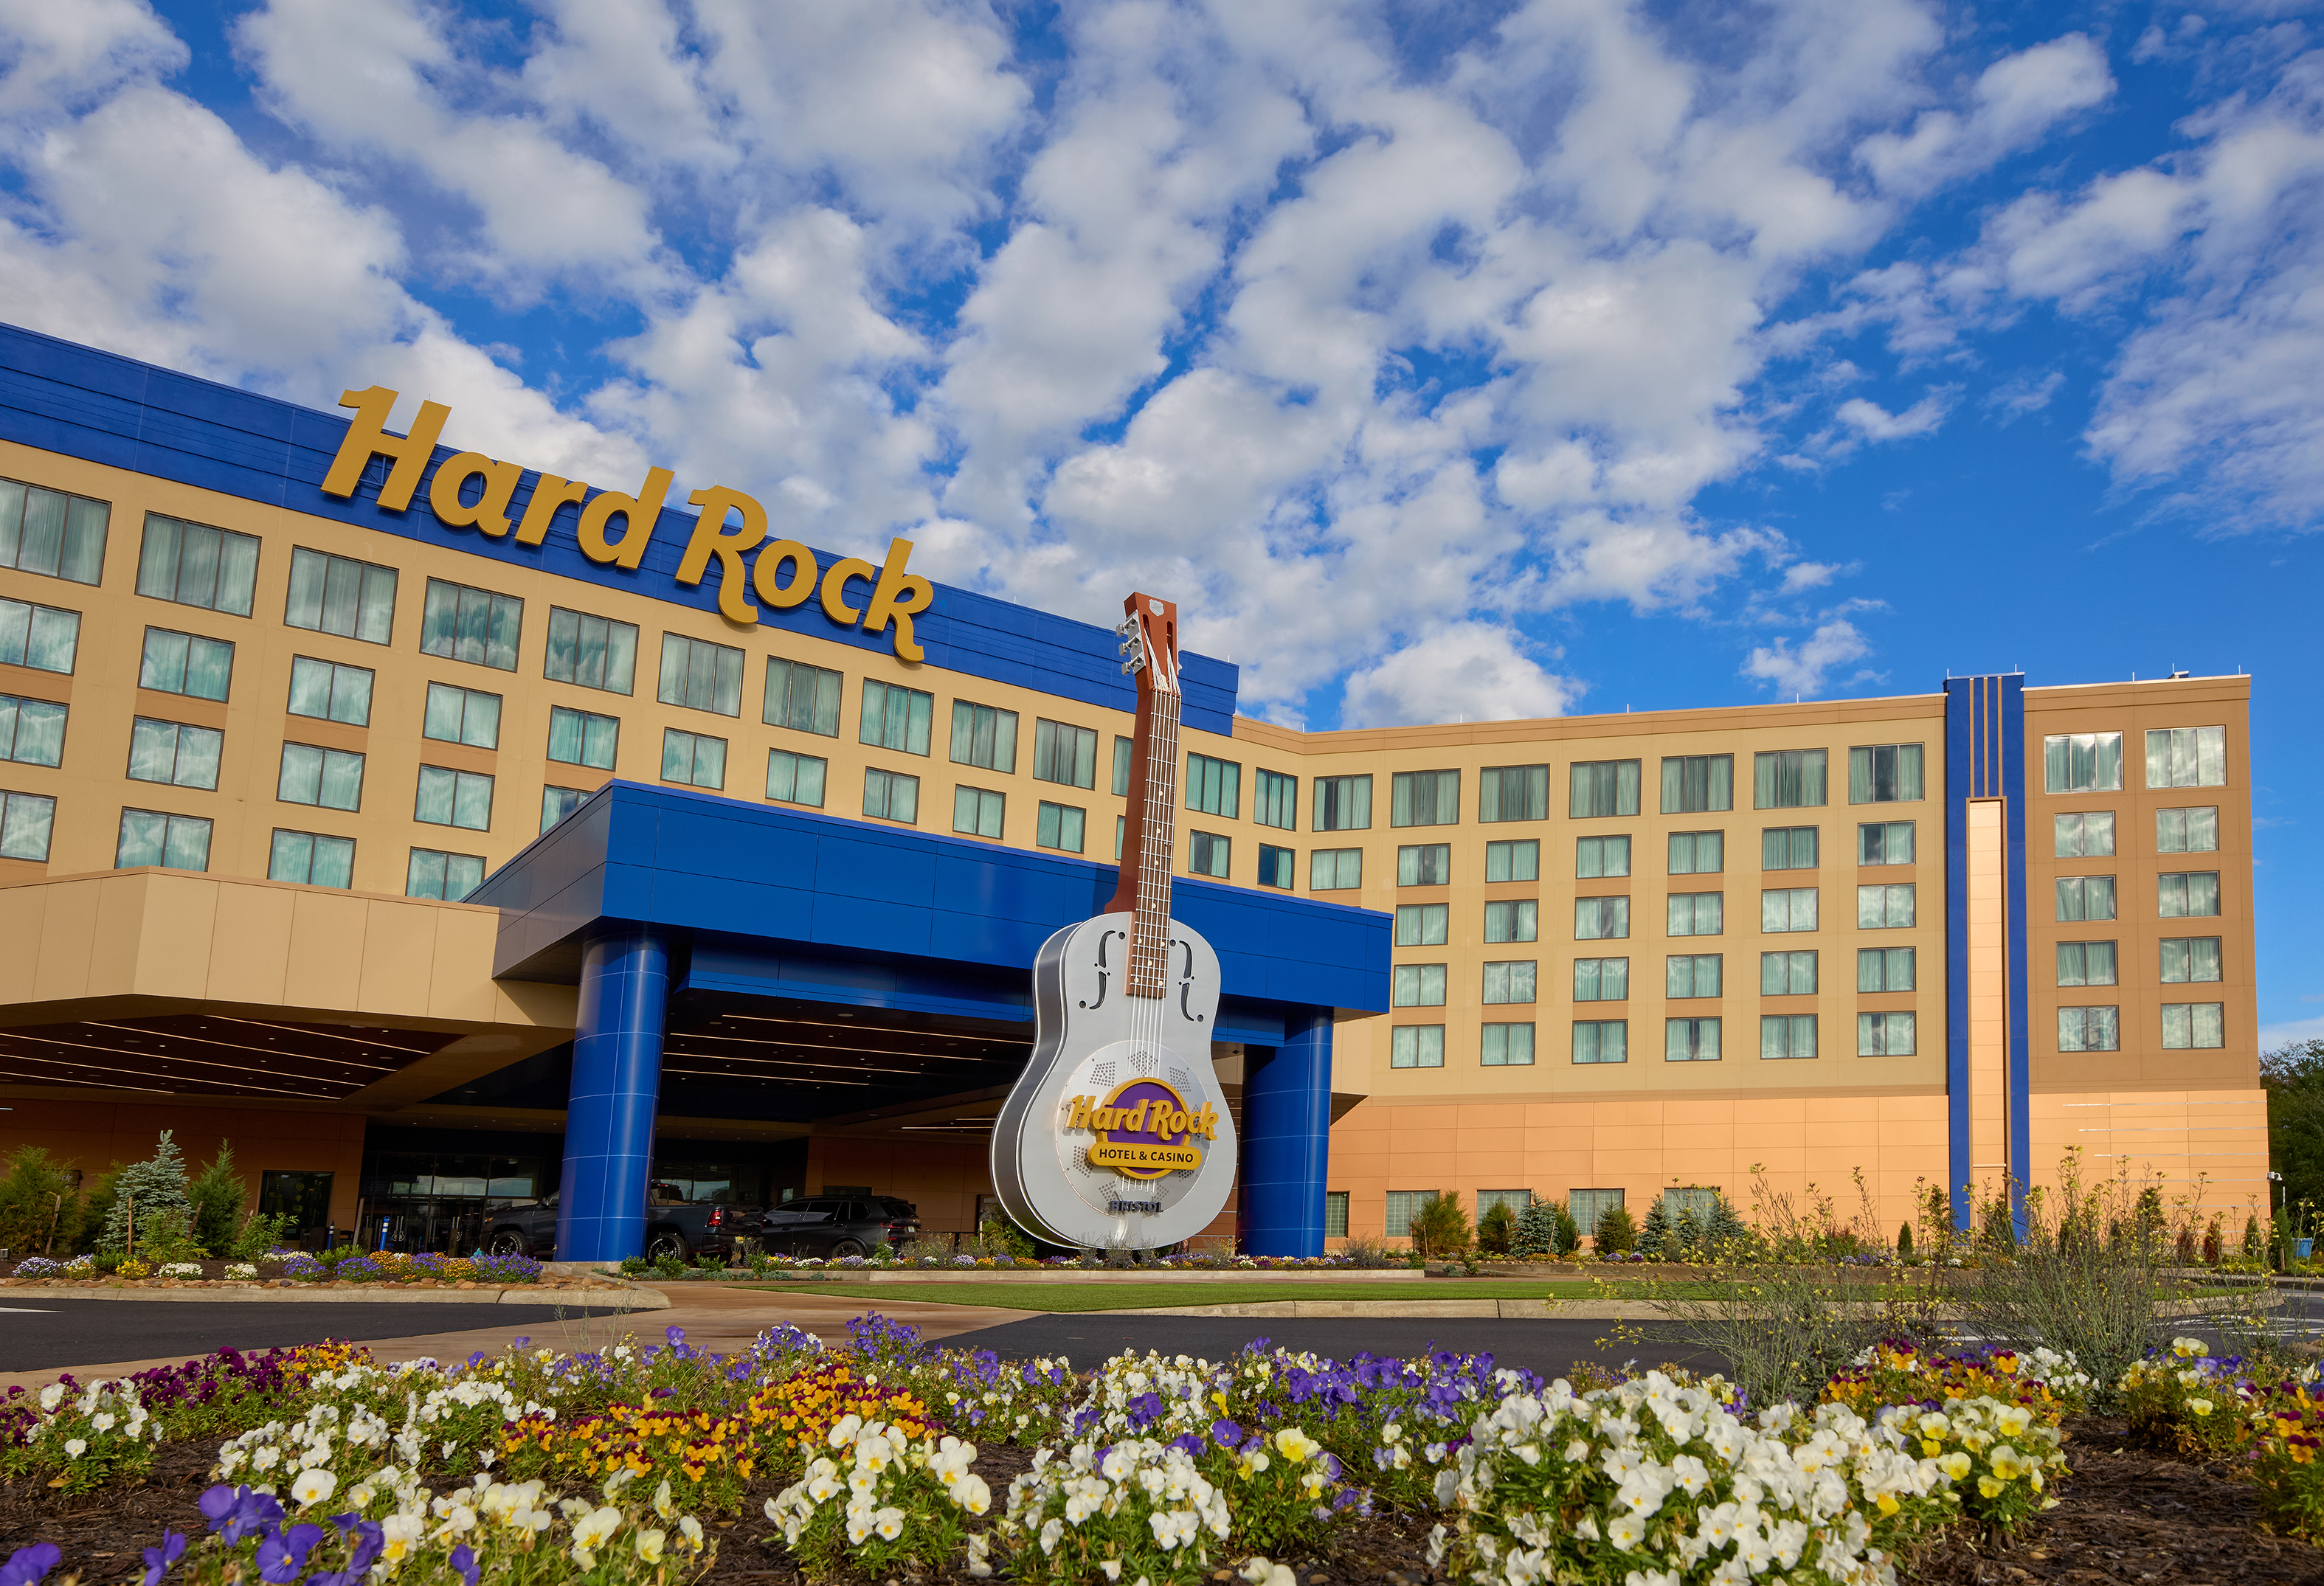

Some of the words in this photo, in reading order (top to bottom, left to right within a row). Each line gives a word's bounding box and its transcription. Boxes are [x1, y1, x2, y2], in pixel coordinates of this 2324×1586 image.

[321, 385, 674, 569] Hard
[675, 485, 933, 662] Rock
[1066, 1095, 1149, 1131] Hard
[1148, 1100, 1219, 1140] Rock
[1099, 1149, 1136, 1160] HOTEL
[1138, 1151, 1147, 1160] &
[1150, 1152, 1194, 1163] CASINO
[1110, 1200, 1163, 1213] BRISTOL
